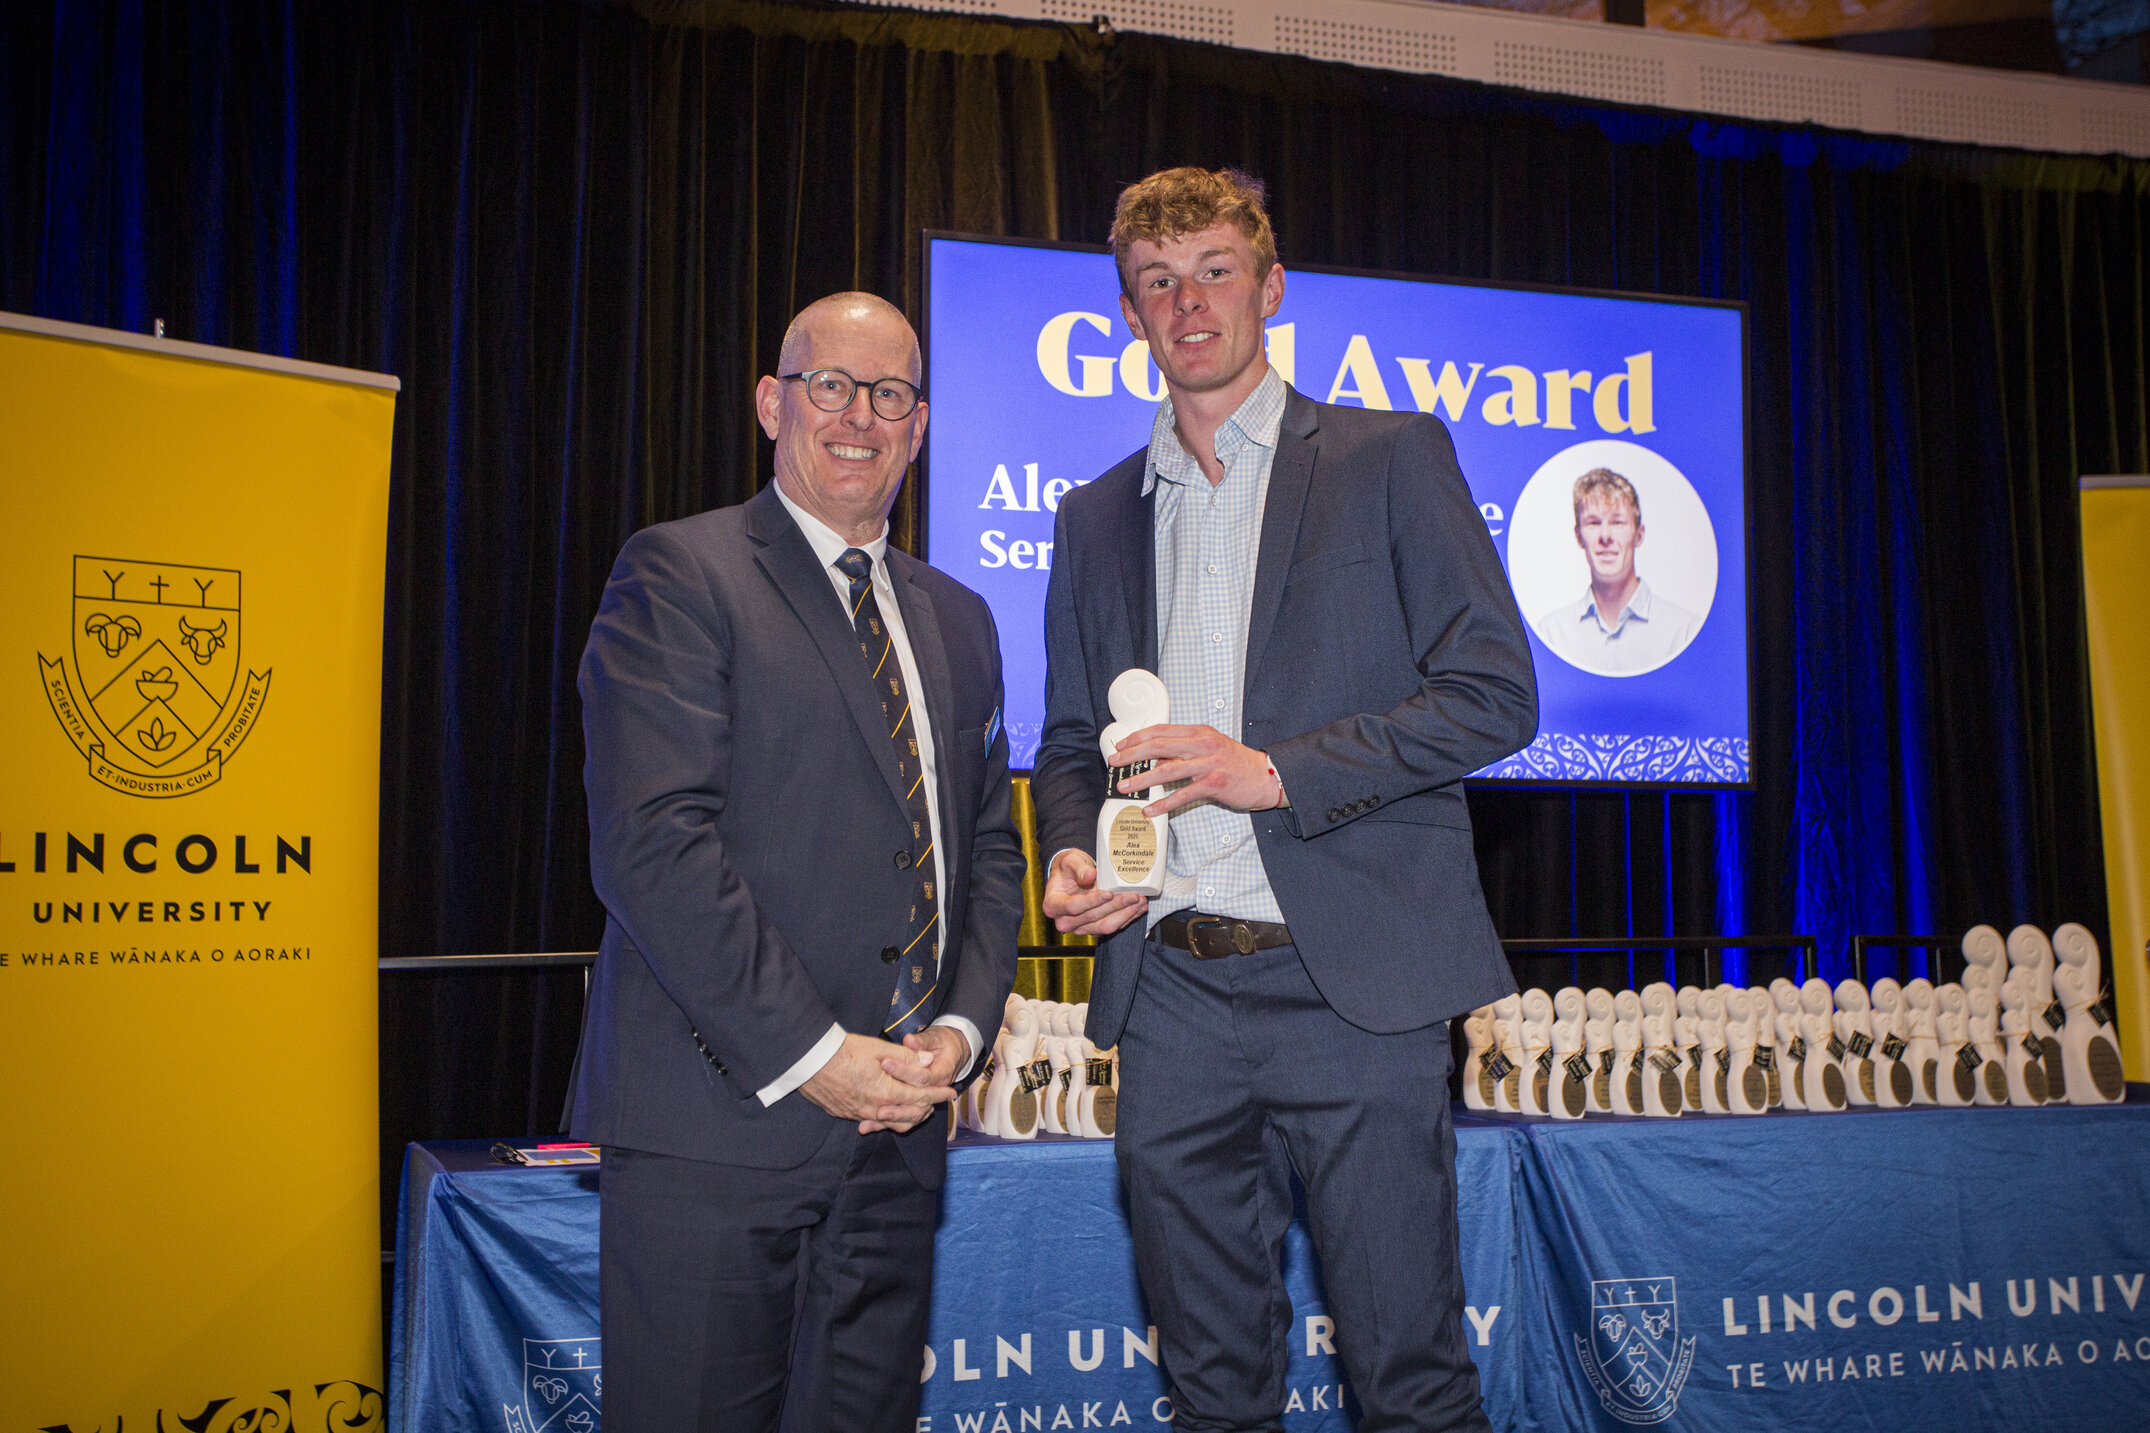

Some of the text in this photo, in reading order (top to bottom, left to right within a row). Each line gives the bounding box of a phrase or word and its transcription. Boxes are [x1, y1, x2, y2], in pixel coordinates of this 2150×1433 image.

[1326, 335, 1656, 435] Award
[978, 462, 1092, 513] Ale
[51, 679, 85, 740] SCIENTIA
[224, 687, 261, 747] PROBITATE
[1112, 849, 1155, 857] McCorkindale
[1122, 858, 1146, 866] Service
[1126, 841, 1141, 849] Alex
[1117, 865, 1150, 873] Excellence
[33, 900, 272, 924] UNIVERSITY
[21, 951, 100, 966] WHARE
[110, 947, 201, 964] WĀNAKA
[211, 948, 225, 962] O
[233, 947, 312, 961] AORAKI
[1722, 1281, 1984, 1337] LINCOLN
[1726, 1362, 1767, 1389] TE
[1783, 1352, 1905, 1385] WHARE
[1919, 1341, 2064, 1374] WĀNAKA
[2077, 1339, 2099, 1364] O
[954, 1399, 1132, 1433] WĀNAKA
[1151, 1396, 1176, 1422] O
